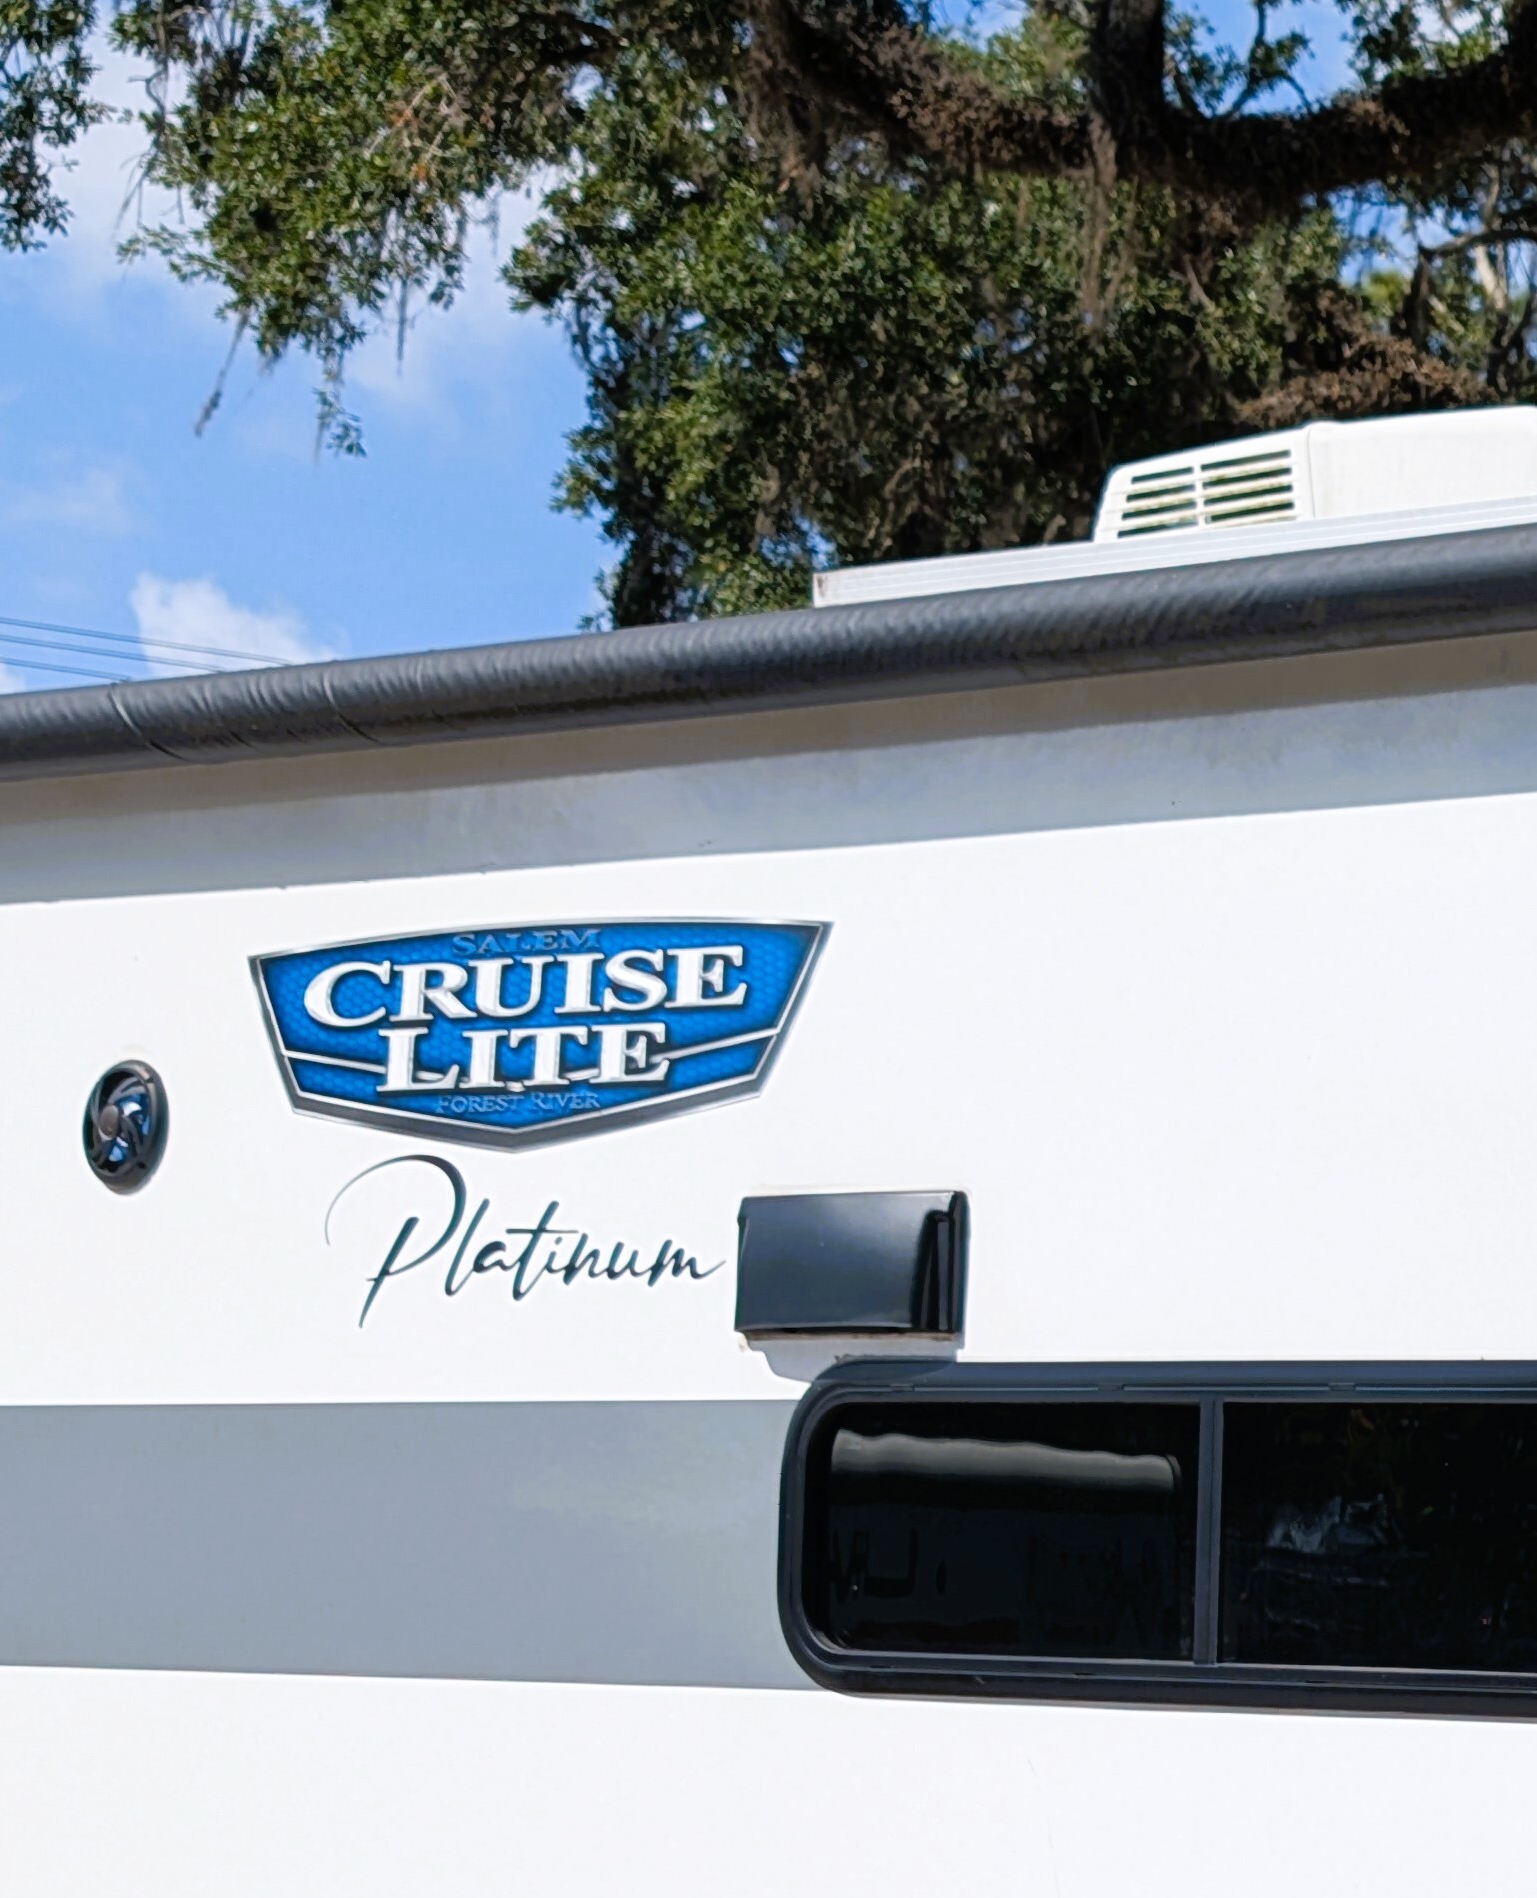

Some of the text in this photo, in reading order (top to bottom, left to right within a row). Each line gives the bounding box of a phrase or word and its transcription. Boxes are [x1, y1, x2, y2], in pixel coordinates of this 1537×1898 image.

[452, 928, 602, 956] SALEM
[302, 943, 748, 1029] CRUISE
[375, 1019, 669, 1096] LITE
[435, 1091, 601, 1115] FOREST RIVER
[324, 1154, 727, 1329] Platinum
